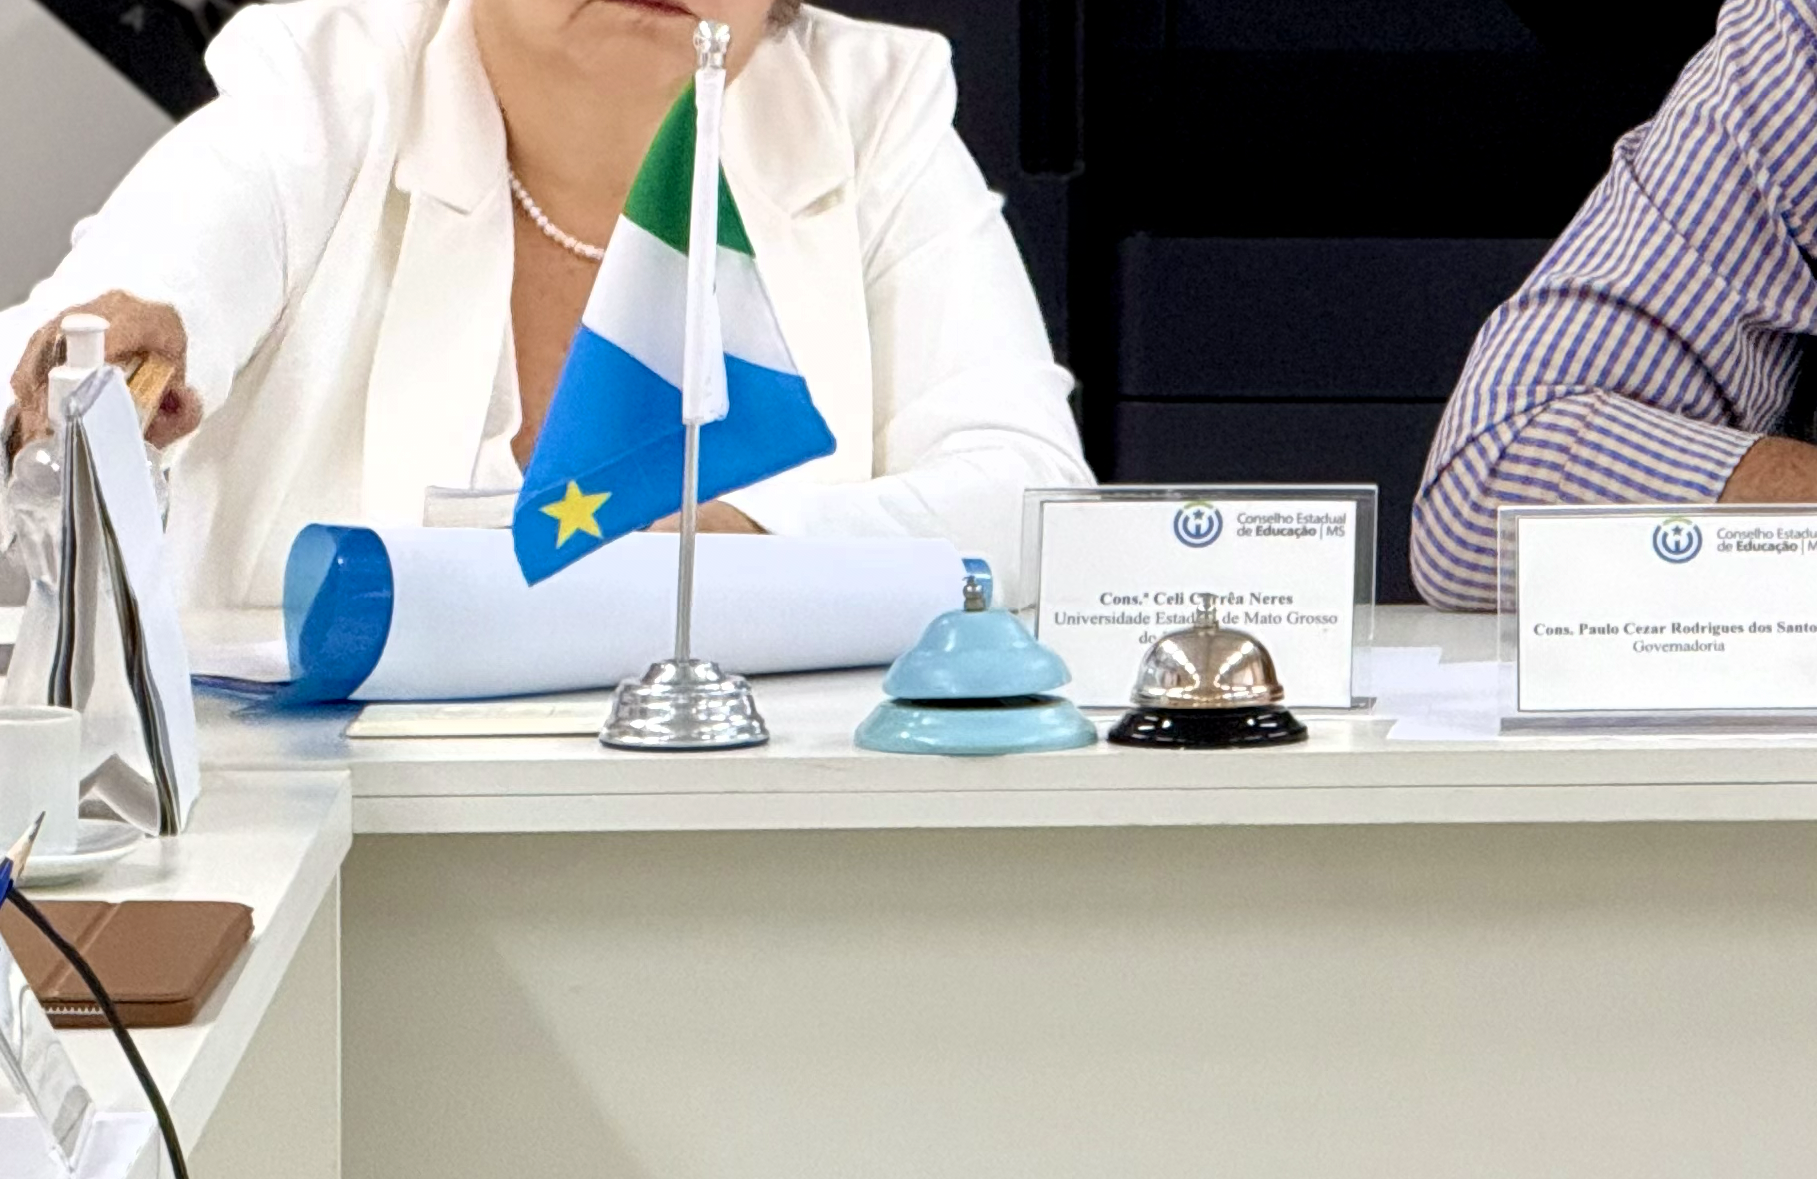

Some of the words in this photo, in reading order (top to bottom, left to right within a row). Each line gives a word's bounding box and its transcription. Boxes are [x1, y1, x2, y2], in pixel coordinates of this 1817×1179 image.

[1236, 512, 1294, 525] Conselho
[1296, 511, 1347, 525] Estadual
[1236, 525, 1253, 537] de
[1255, 525, 1317, 539] Educação
[1326, 526, 1346, 537] MS
[1716, 528, 1774, 540] Conselho
[1716, 540, 1733, 552] de
[1736, 540, 1798, 554] Educação
[1153, 592, 1184, 606] Celi
[1249, 591, 1294, 605] Neres
[1054, 611, 1151, 625] Universidade
[1221, 610, 1240, 625] de
[1244, 610, 1282, 625] Mato
[1286, 610, 1338, 625] Grosso
[1533, 622, 1575, 636] Cons.
[1578, 622, 1620, 635] Paulo
[1623, 621, 1666, 635] Cezar
[1671, 620, 1745, 637] Rodrigues
[1748, 621, 1773, 634] dos
[1632, 639, 1726, 654] Governadoria
